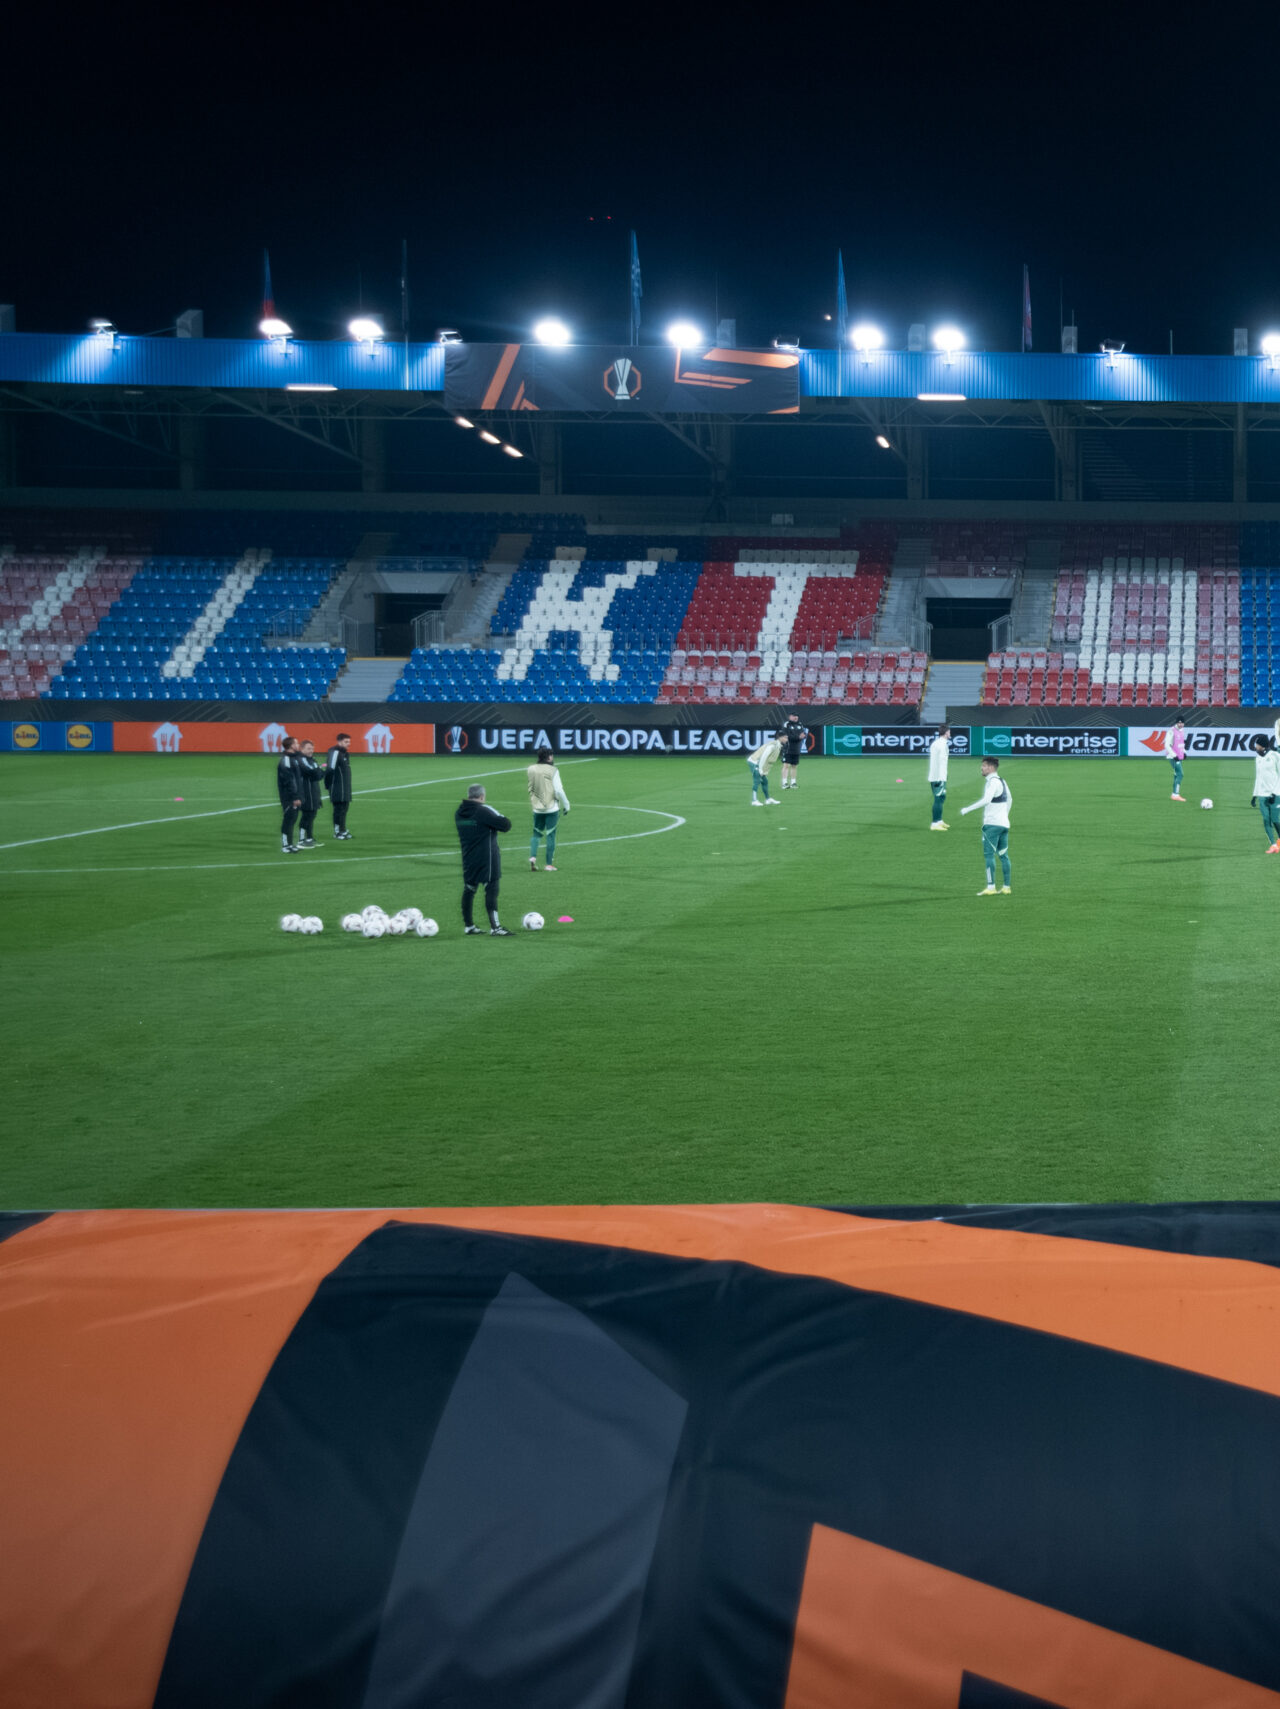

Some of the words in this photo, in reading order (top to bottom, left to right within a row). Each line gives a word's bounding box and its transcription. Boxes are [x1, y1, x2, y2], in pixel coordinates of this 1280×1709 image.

[480, 729, 552, 750] UEFA
[560, 729, 666, 750] EUROPA
[674, 730, 777, 750] LEAGUE
[842, 731, 968, 751] enterprie
[992, 732, 1117, 751] enterprise
